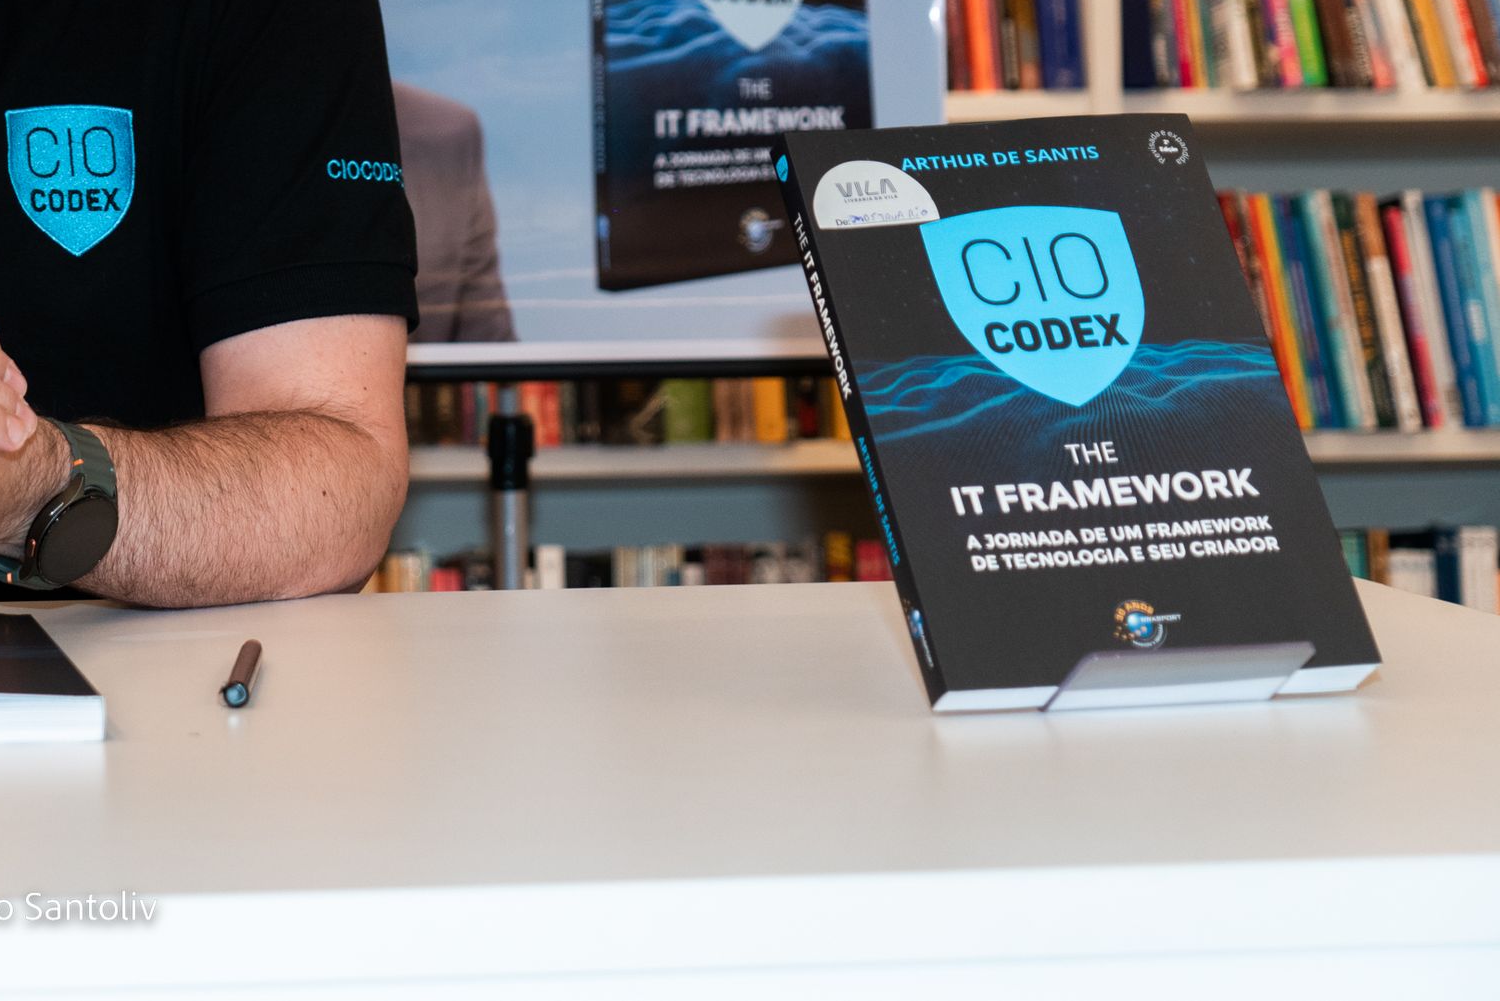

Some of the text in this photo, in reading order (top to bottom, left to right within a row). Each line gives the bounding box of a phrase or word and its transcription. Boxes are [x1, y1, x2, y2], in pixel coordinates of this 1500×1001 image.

[739, 78, 772, 100] THE
[654, 105, 846, 138] IT FRAMEWORK
[25, 126, 117, 179] CIO
[901, 146, 1100, 172] ARTHUR DE SANTIS
[29, 187, 122, 213] CODEX
[835, 178, 898, 198] VILA
[961, 232, 1109, 306] CIO
[794, 212, 853, 401] THE IT FRAMEWORK
[984, 313, 1130, 355] CODEX
[1064, 440, 1119, 466] THE
[857, 436, 901, 566] ARTHUR DE SANTIS
[950, 467, 1261, 516] IT FRAMEWORK
[966, 515, 1273, 550] A JORNADA DE UM FRAMEWORK
[971, 535, 1281, 573] DE TECNOLOGIA E SEU CRIADOR
